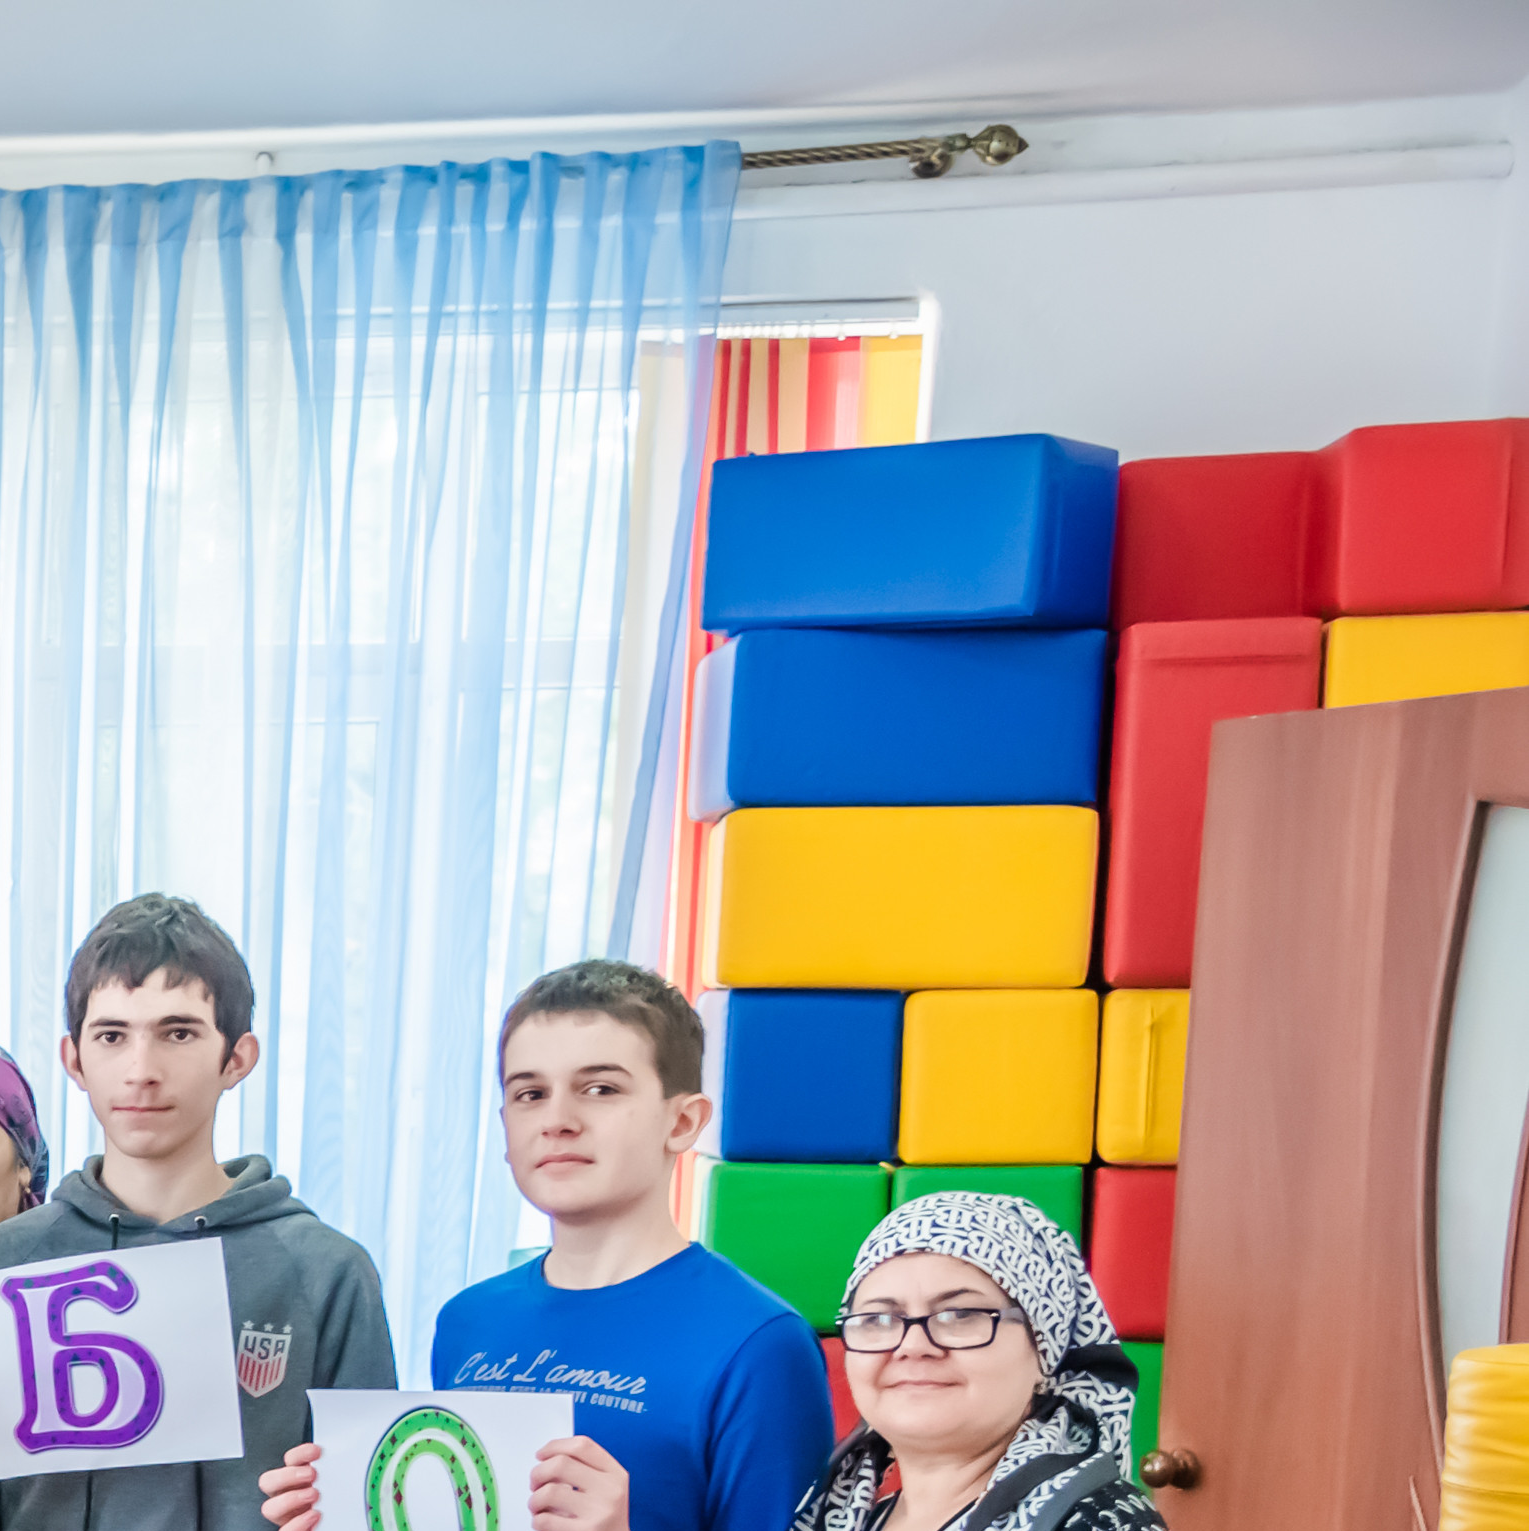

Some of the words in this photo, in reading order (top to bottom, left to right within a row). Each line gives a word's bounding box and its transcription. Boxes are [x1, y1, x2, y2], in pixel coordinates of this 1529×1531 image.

[1, 1260, 164, 1455] Б
[244, 1335, 286, 1360] USA
[454, 1351, 518, 1384] C'est
[513, 1349, 647, 1394] L'amour
